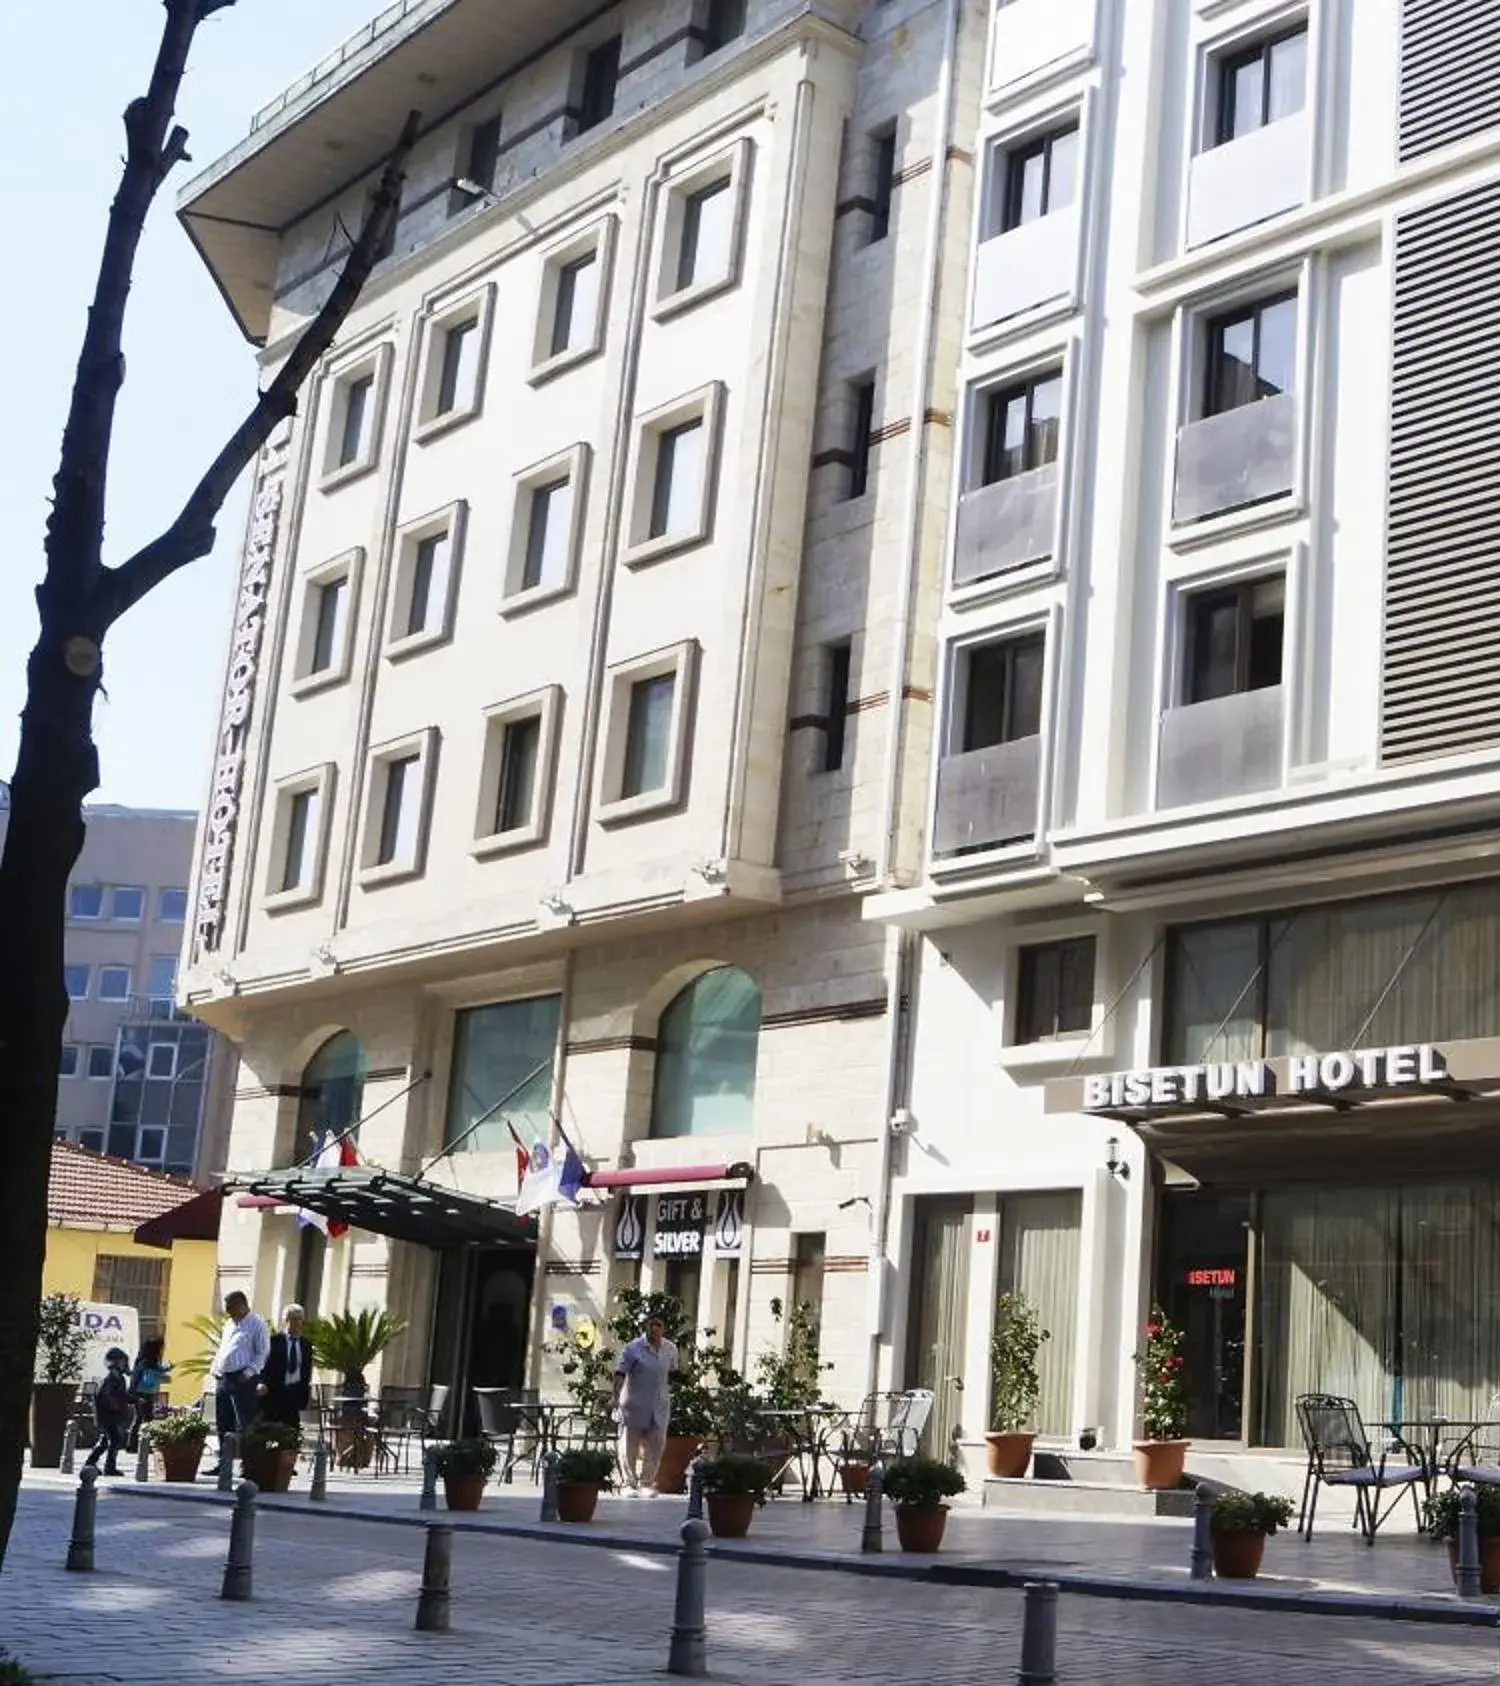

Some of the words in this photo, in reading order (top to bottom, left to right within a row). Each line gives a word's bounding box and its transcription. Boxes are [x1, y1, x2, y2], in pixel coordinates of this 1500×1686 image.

[1083, 1060, 1266, 1109] BISETUN
[1289, 1043, 1447, 1093] HOTEL
[657, 1199, 688, 1222] GIFT
[691, 1197, 703, 1220] &
[653, 1230, 702, 1254] SILVER
[1184, 1269, 1236, 1285] ISETUN
